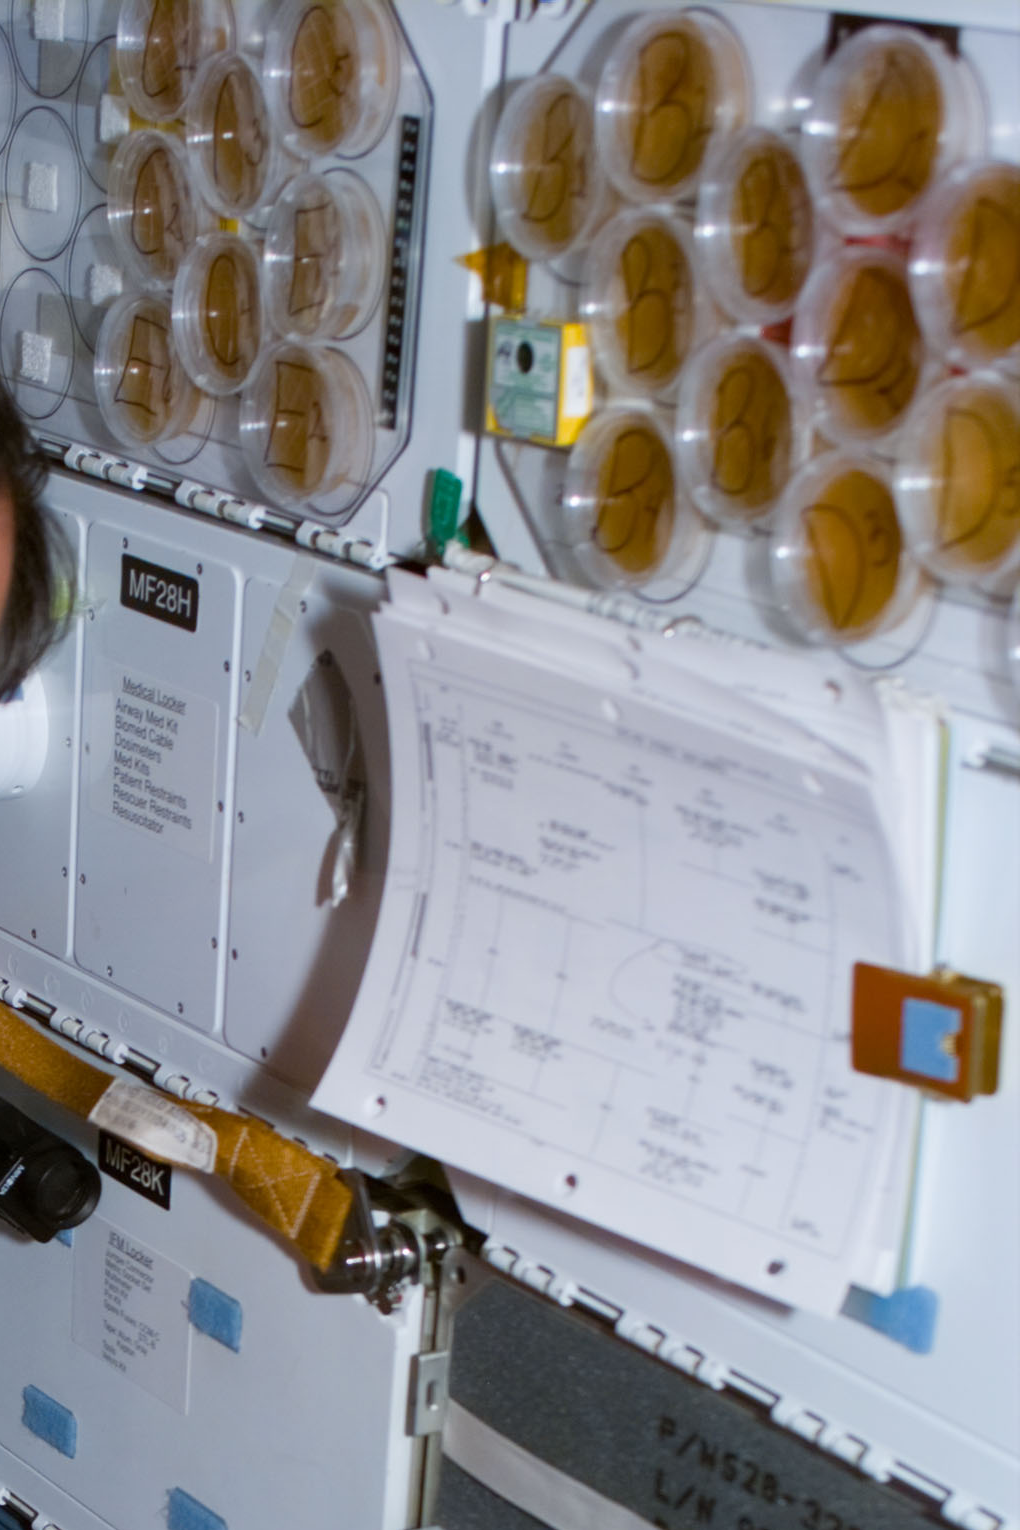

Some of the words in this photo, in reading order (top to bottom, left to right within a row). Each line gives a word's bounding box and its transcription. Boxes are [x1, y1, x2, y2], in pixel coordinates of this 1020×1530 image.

[129, 569, 192, 618] MF28H
[122, 675, 156, 703] Medical
[158, 690, 186, 714] Locker
[116, 698, 143, 724] Airway
[146, 709, 165, 729] Med
[166, 718, 178, 735] Kit
[116, 715, 147, 740] Biomed
[149, 729, 174, 751] Cable
[114, 749, 132, 769] Med
[115, 732, 161, 764] Dosimeters
[114, 766, 142, 791] Patient
[144, 779, 187, 810] Restraints
[149, 799, 192, 830] Restraints
[106, 1139, 165, 1196] MF28K
